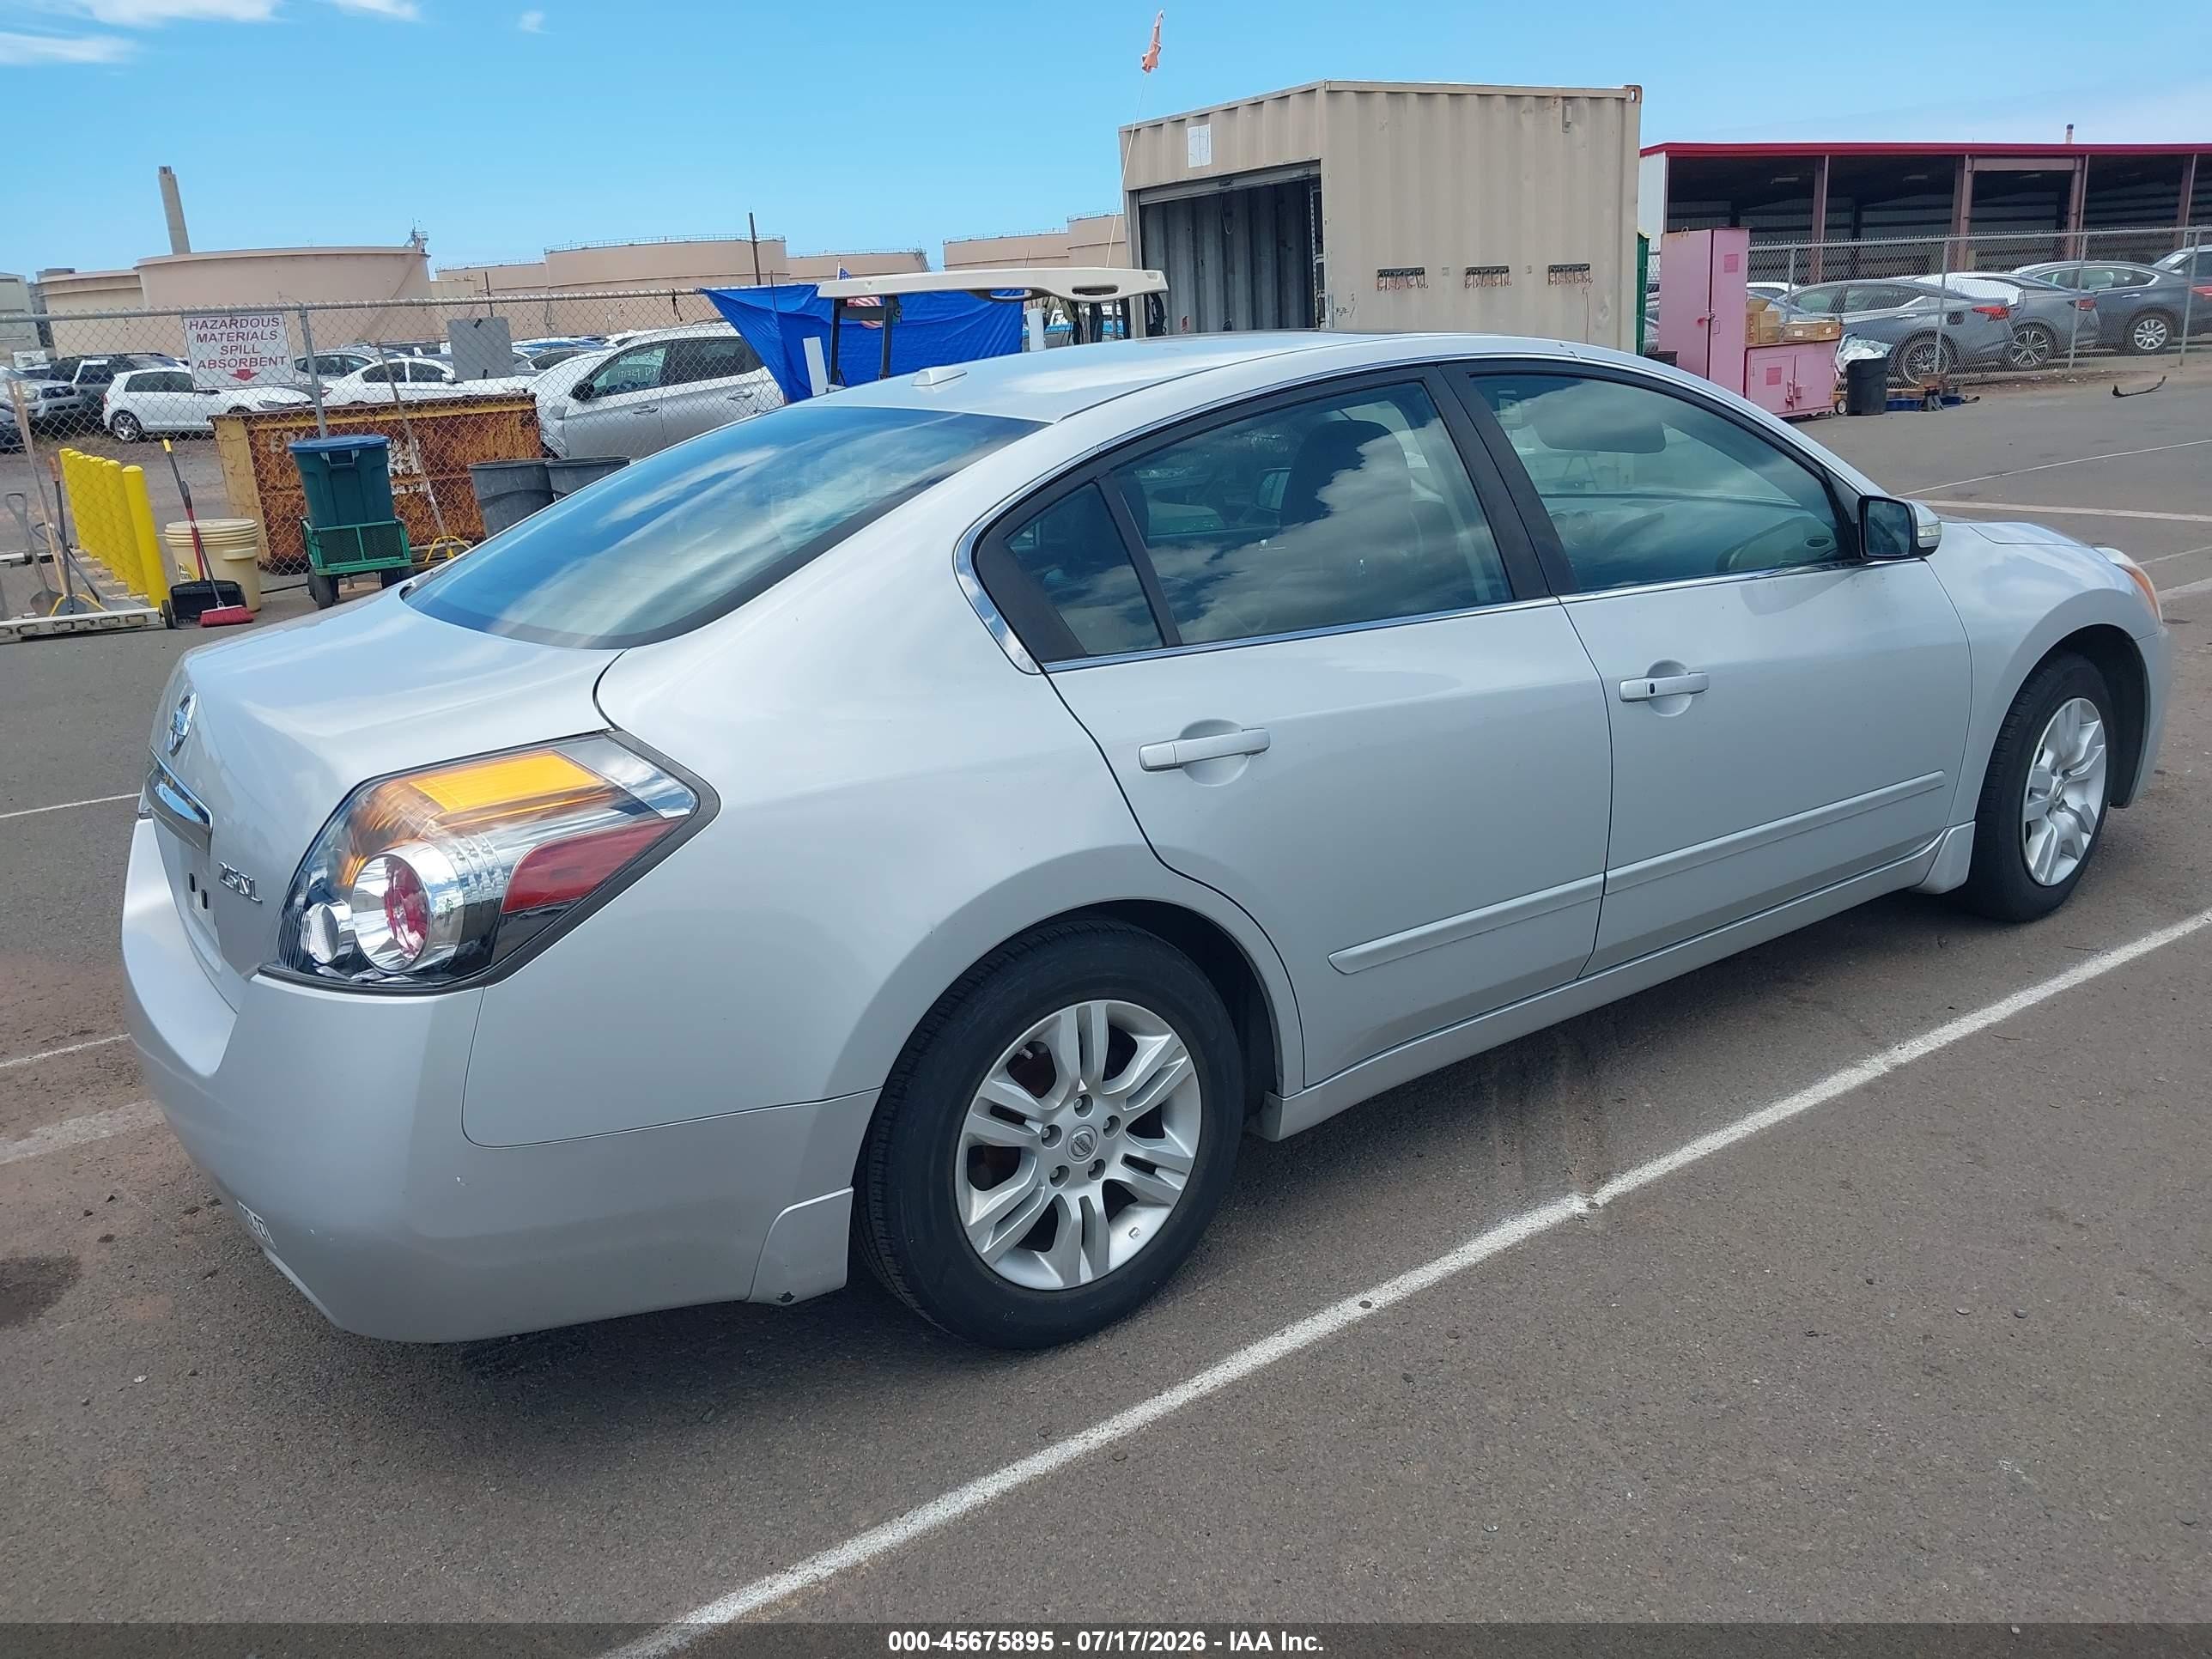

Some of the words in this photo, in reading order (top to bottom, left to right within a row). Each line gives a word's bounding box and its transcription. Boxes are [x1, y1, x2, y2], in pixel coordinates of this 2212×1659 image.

[189, 317, 280, 331] HAZARDOUS
[196, 330, 278, 343] MATERIALS
[220, 344, 261, 356] SPILL
[197, 356, 287, 370] ABSORBENT
